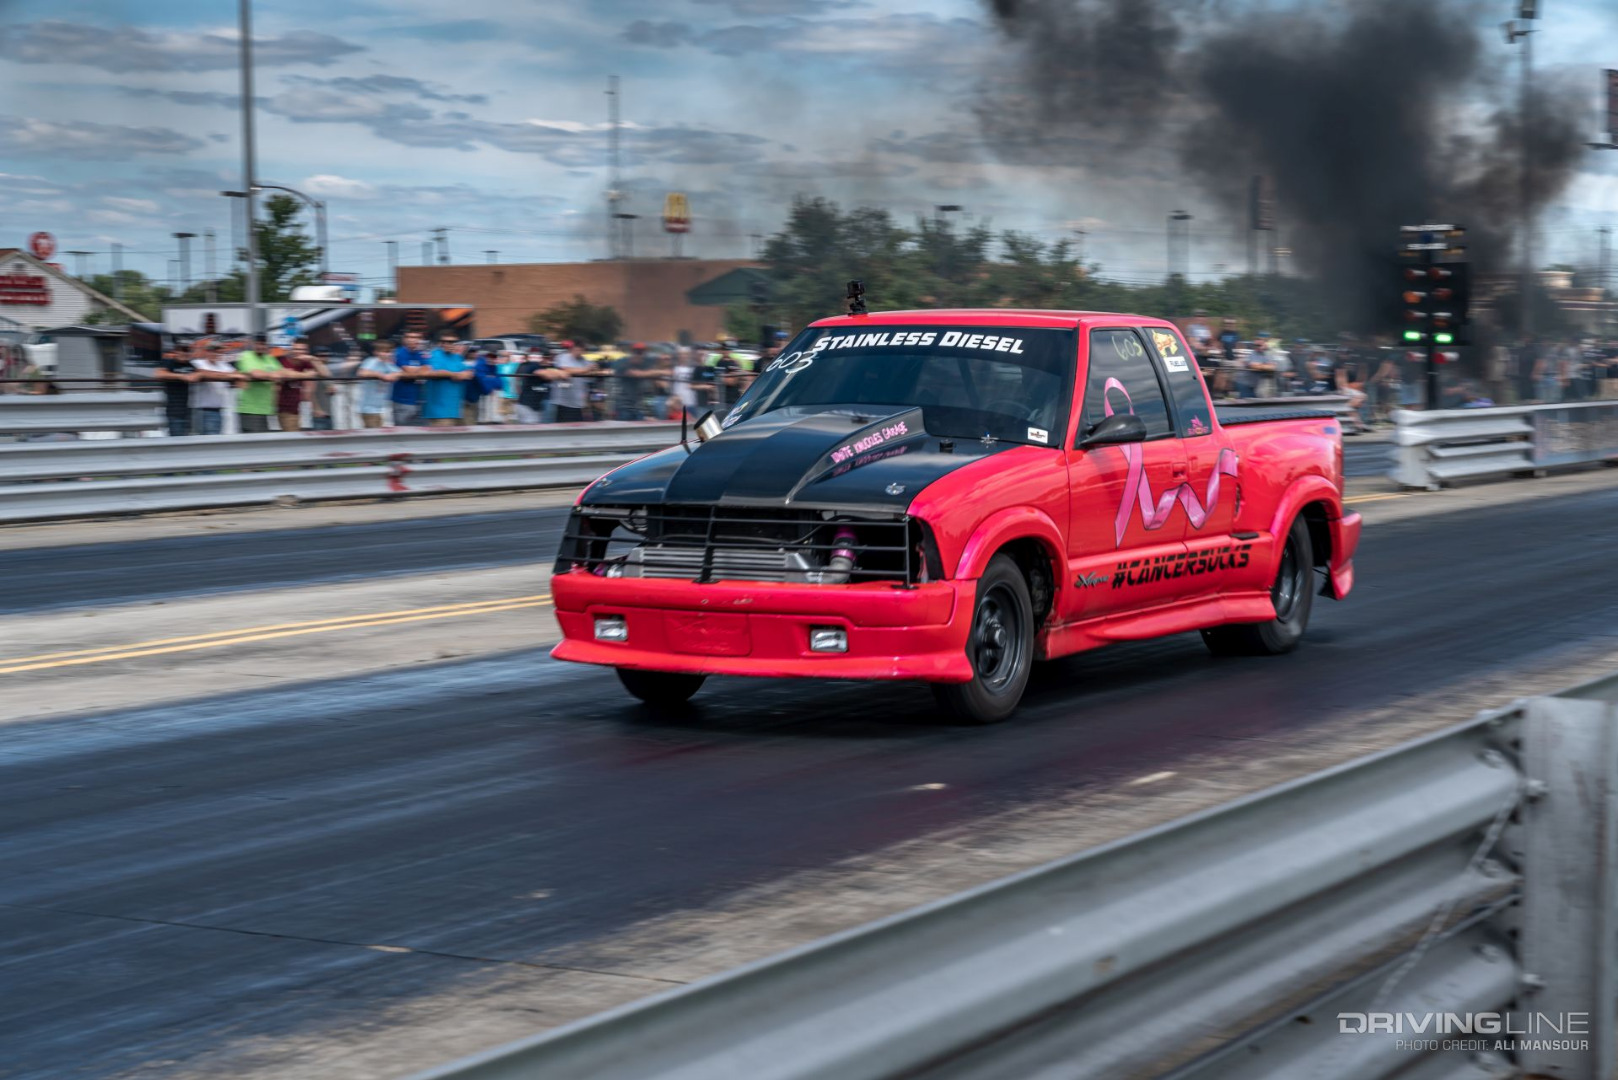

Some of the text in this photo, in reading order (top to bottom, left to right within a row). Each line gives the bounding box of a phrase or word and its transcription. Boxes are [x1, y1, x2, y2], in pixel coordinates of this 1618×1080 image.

[814, 331, 1024, 354] STAINLESS DIESEL
[1111, 336, 1142, 361] 603
[766, 351, 818, 374] 603
[1112, 545, 1251, 589] #CANCERSUCKS
